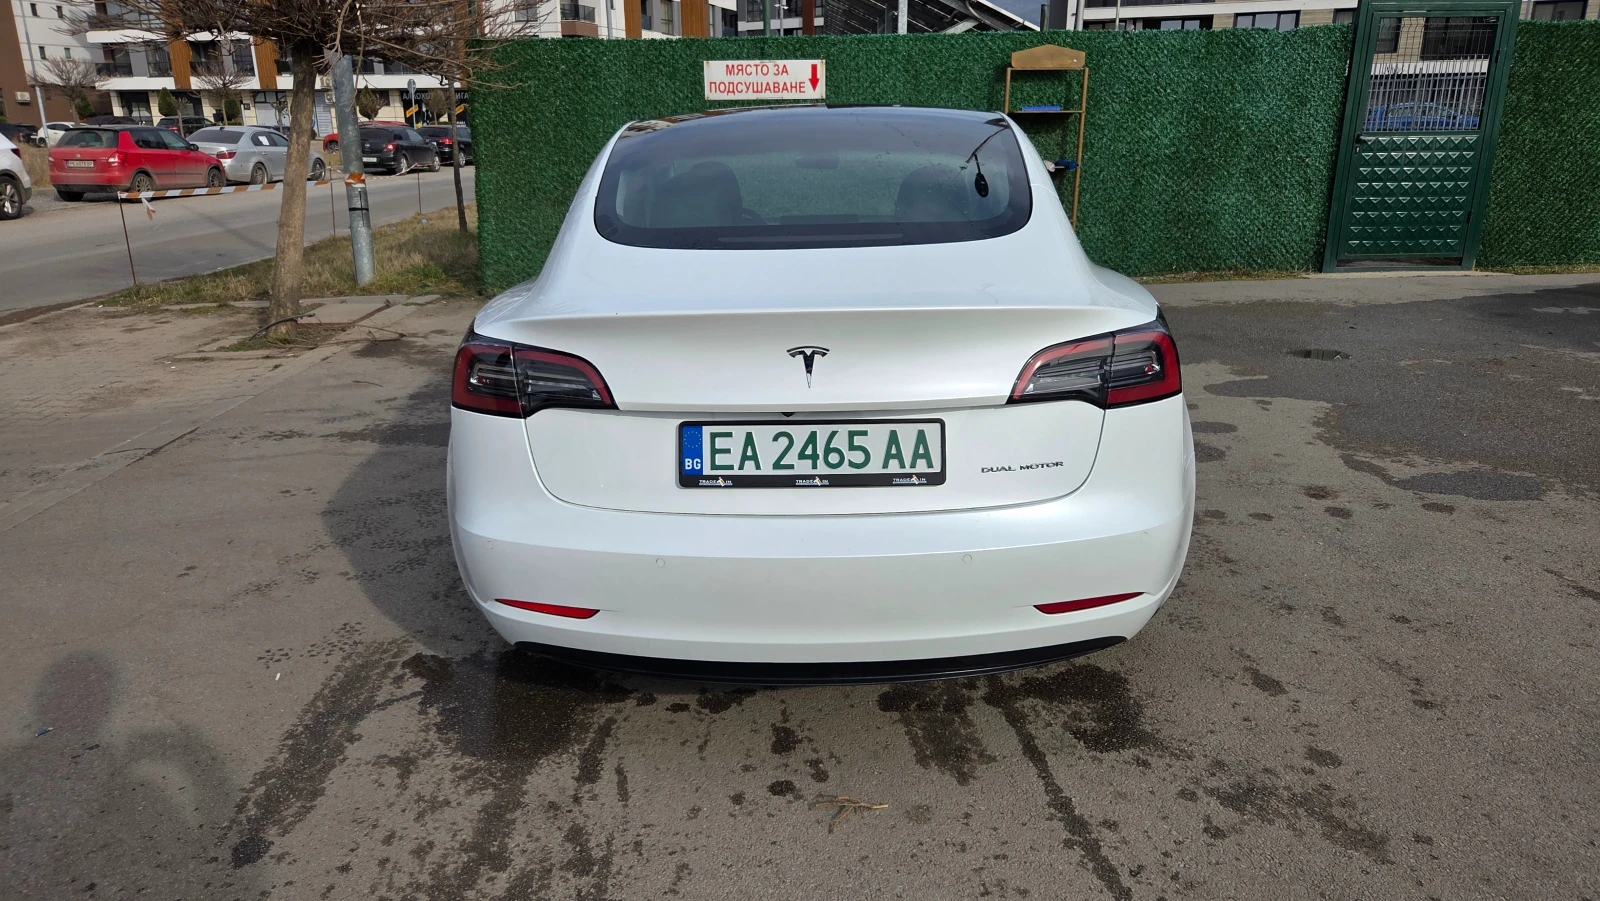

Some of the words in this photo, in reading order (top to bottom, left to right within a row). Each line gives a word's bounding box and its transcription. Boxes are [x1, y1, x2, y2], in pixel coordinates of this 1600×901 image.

[725, 64, 770, 76] МЯСТО
[773, 64, 789, 76] ЗА
[709, 81, 806, 96] ПОДСУШАВАНЕ
[684, 458, 701, 470] BG
[709, 431, 762, 471] EA
[771, 429, 871, 470] 2465
[881, 429, 935, 470] AA
[981, 465, 1016, 473] DUAL
[1019, 461, 1064, 470] MOTOR
